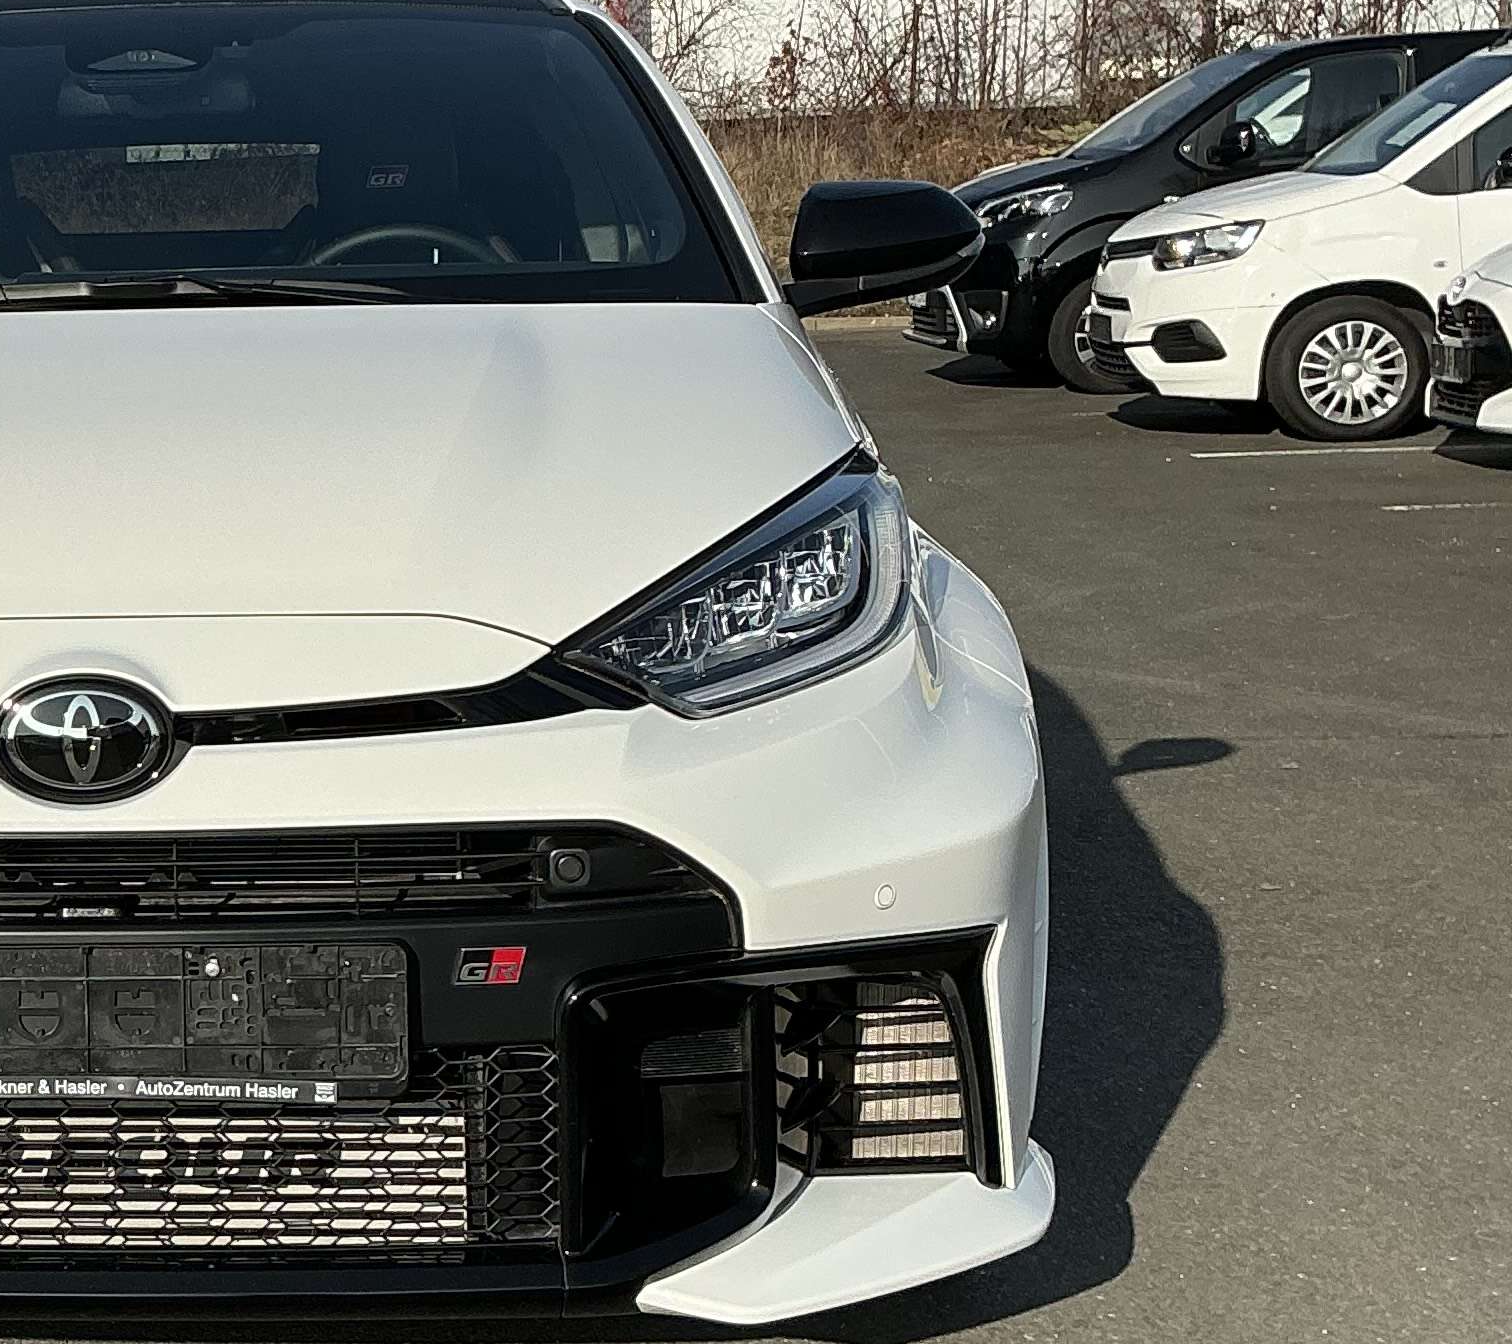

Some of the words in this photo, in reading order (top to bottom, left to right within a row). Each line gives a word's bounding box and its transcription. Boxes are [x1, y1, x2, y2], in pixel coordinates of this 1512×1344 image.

[38, 1079, 50, 1095] &
[55, 1079, 107, 1095] Hasler
[135, 1080, 241, 1097] AutoZentrum
[245, 1082, 299, 1099] Hasler
